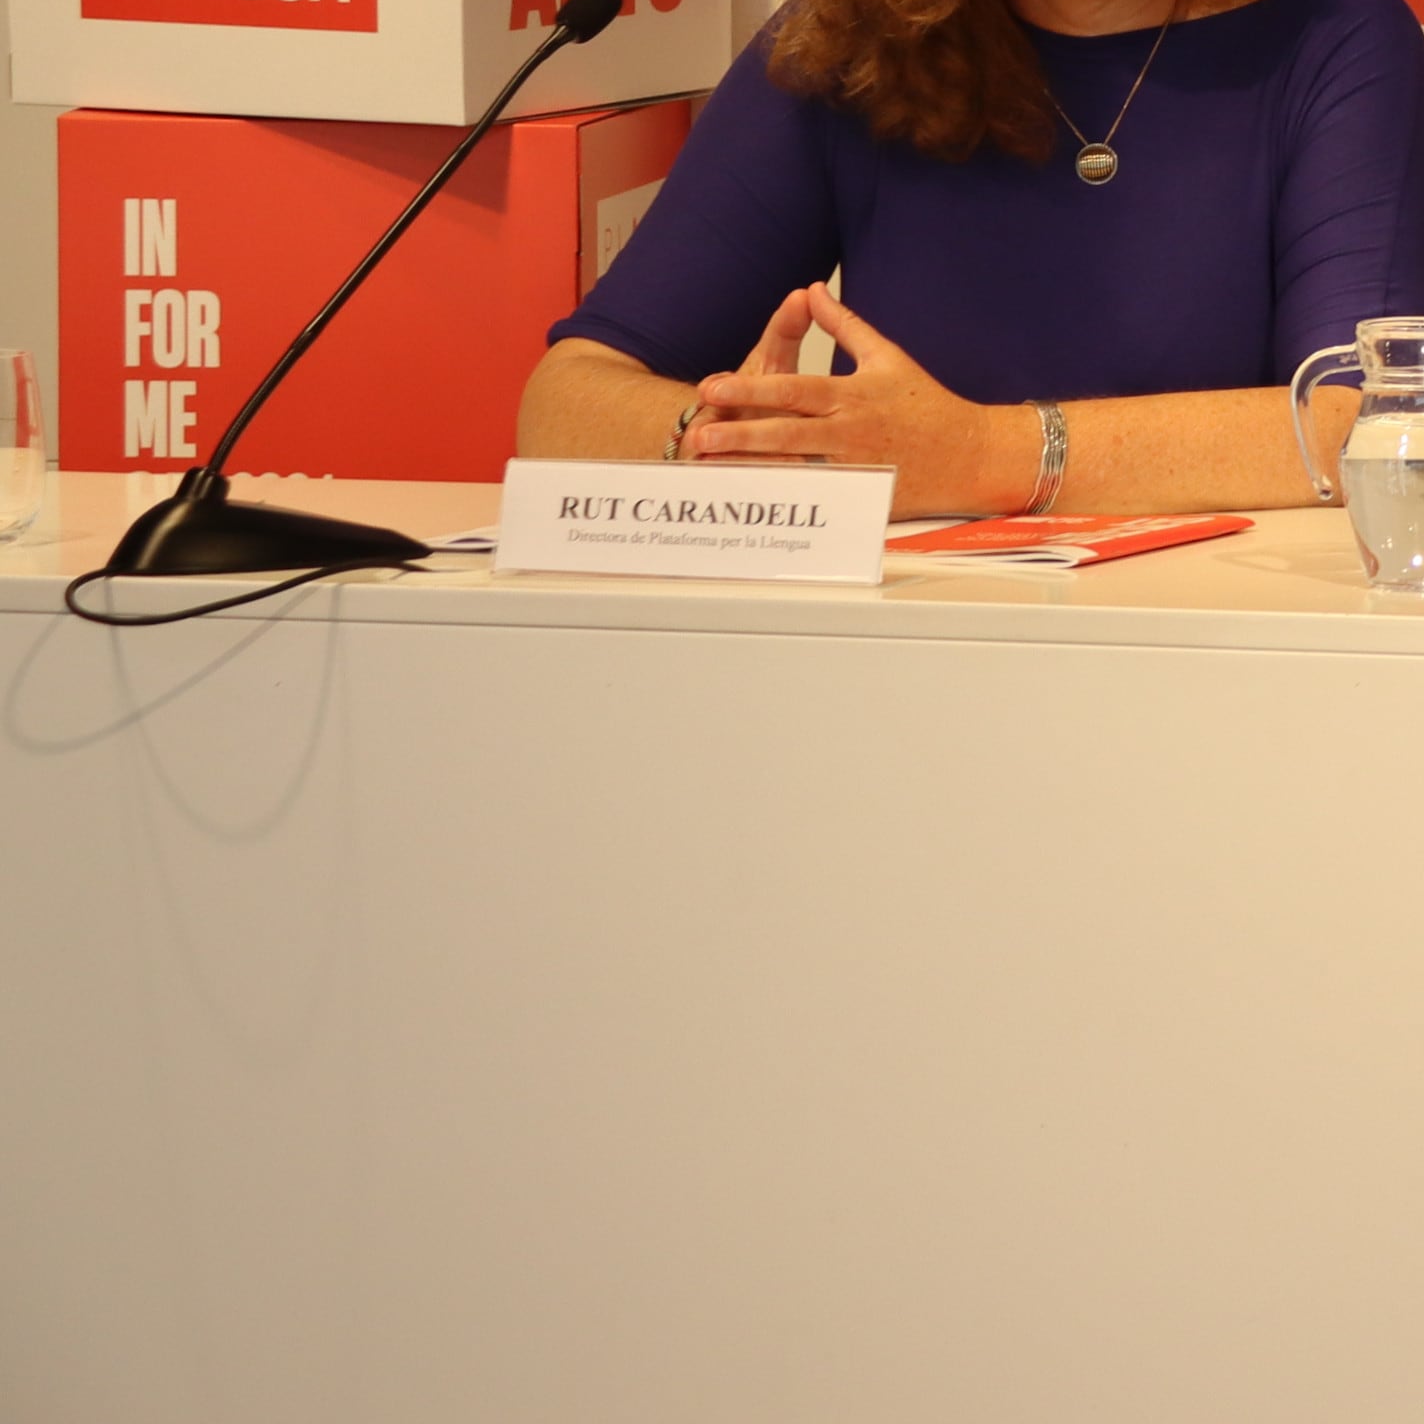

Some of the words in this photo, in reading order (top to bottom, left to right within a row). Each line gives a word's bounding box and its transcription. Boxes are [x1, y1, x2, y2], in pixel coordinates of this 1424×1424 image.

[123, 198, 177, 277] IN
[123, 289, 221, 368] FOR
[124, 380, 197, 459] ME
[558, 496, 625, 521] RUT
[632, 497, 828, 529] CARANDELL
[568, 529, 628, 544] Directora
[631, 530, 646, 545] de
[650, 531, 718, 547] Plataforma
[719, 536, 742, 551] per
[746, 534, 757, 549] la
[760, 535, 811, 552] Llengua
